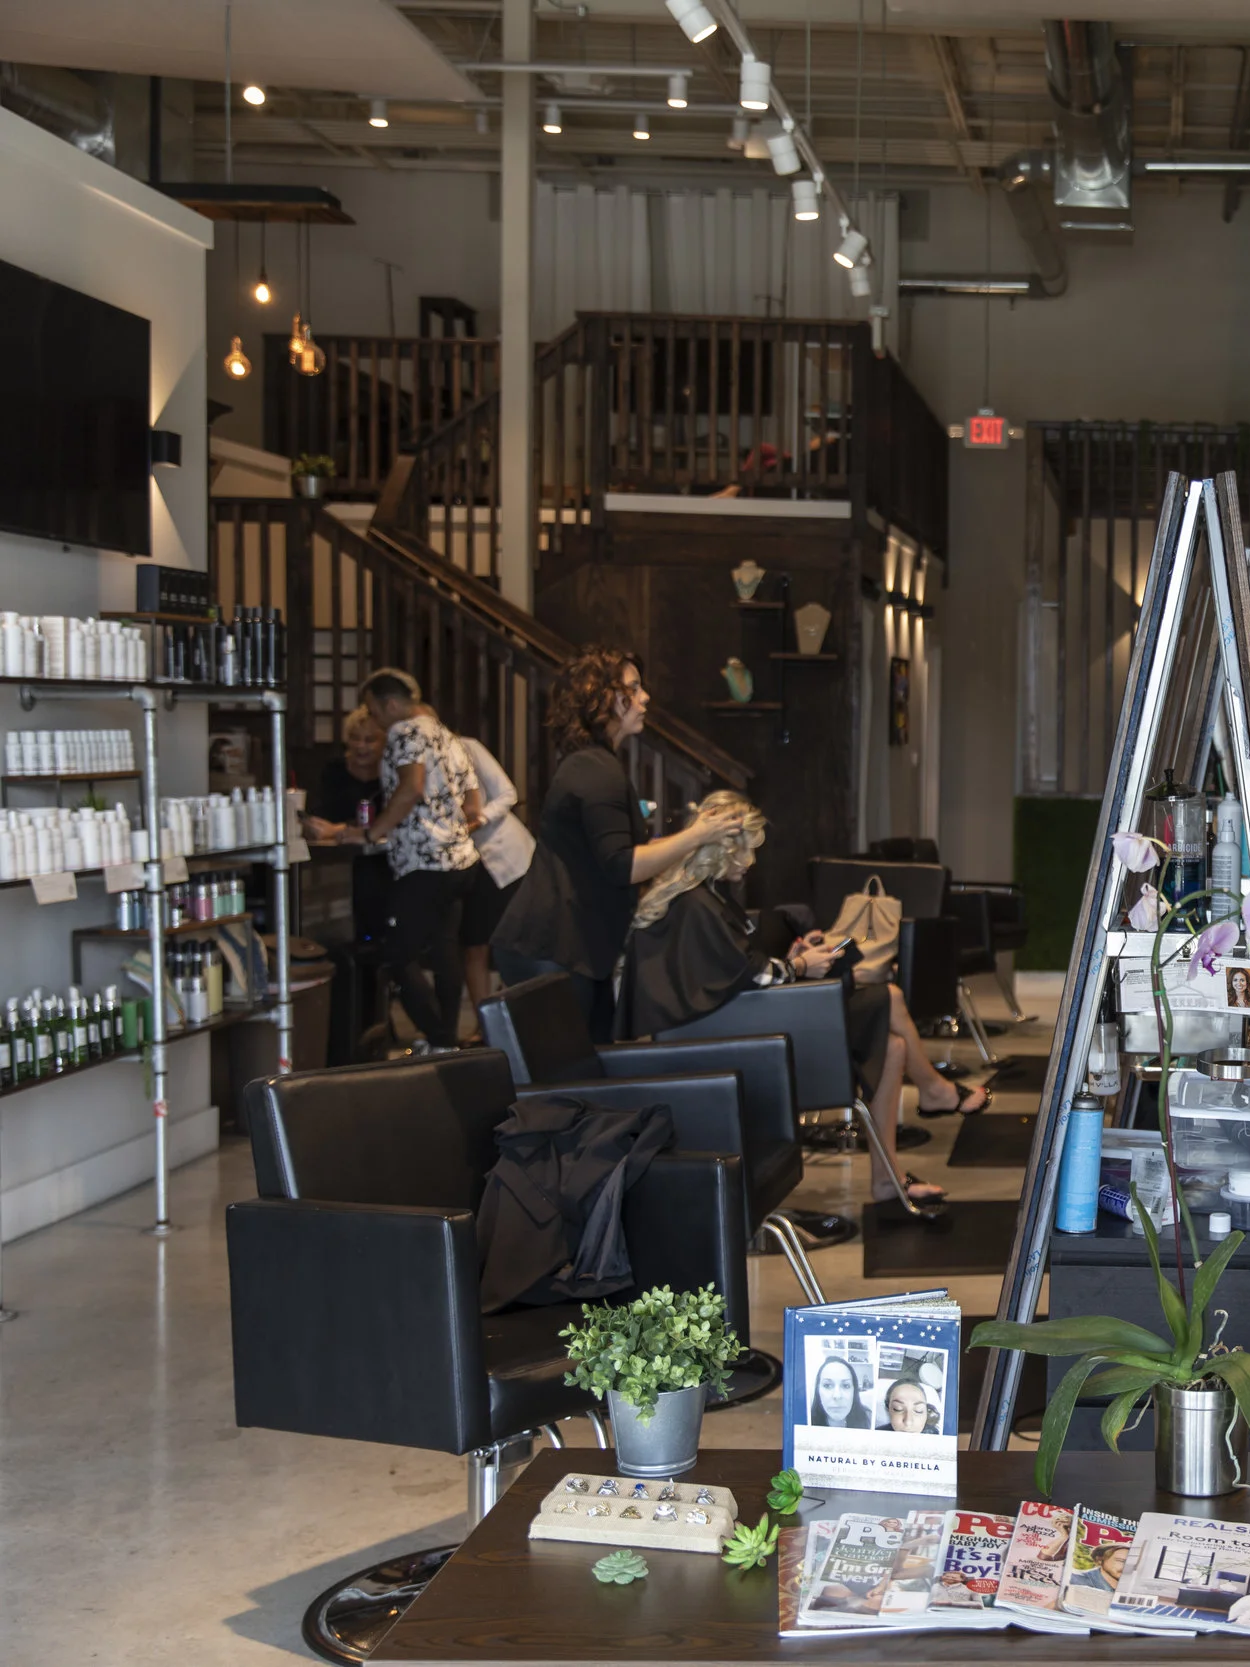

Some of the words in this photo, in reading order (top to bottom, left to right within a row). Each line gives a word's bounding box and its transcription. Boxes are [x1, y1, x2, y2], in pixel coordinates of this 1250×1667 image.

[969, 416, 1004, 444] EXIT
[1166, 843, 1203, 853] ARBICIDE
[808, 1455, 858, 1465] NATURAL
[881, 1460, 940, 1471] GABRIELLA
[1083, 1507, 1119, 1522] INSIDE
[948, 1540, 978, 1548] BABY
[949, 1534, 1008, 1545] MEGHAN'S
[1170, 1531, 1225, 1544] Room
[946, 1545, 983, 1561] It's
[986, 1552, 1001, 1562] a
[943, 1558, 1001, 1578] Boy!
